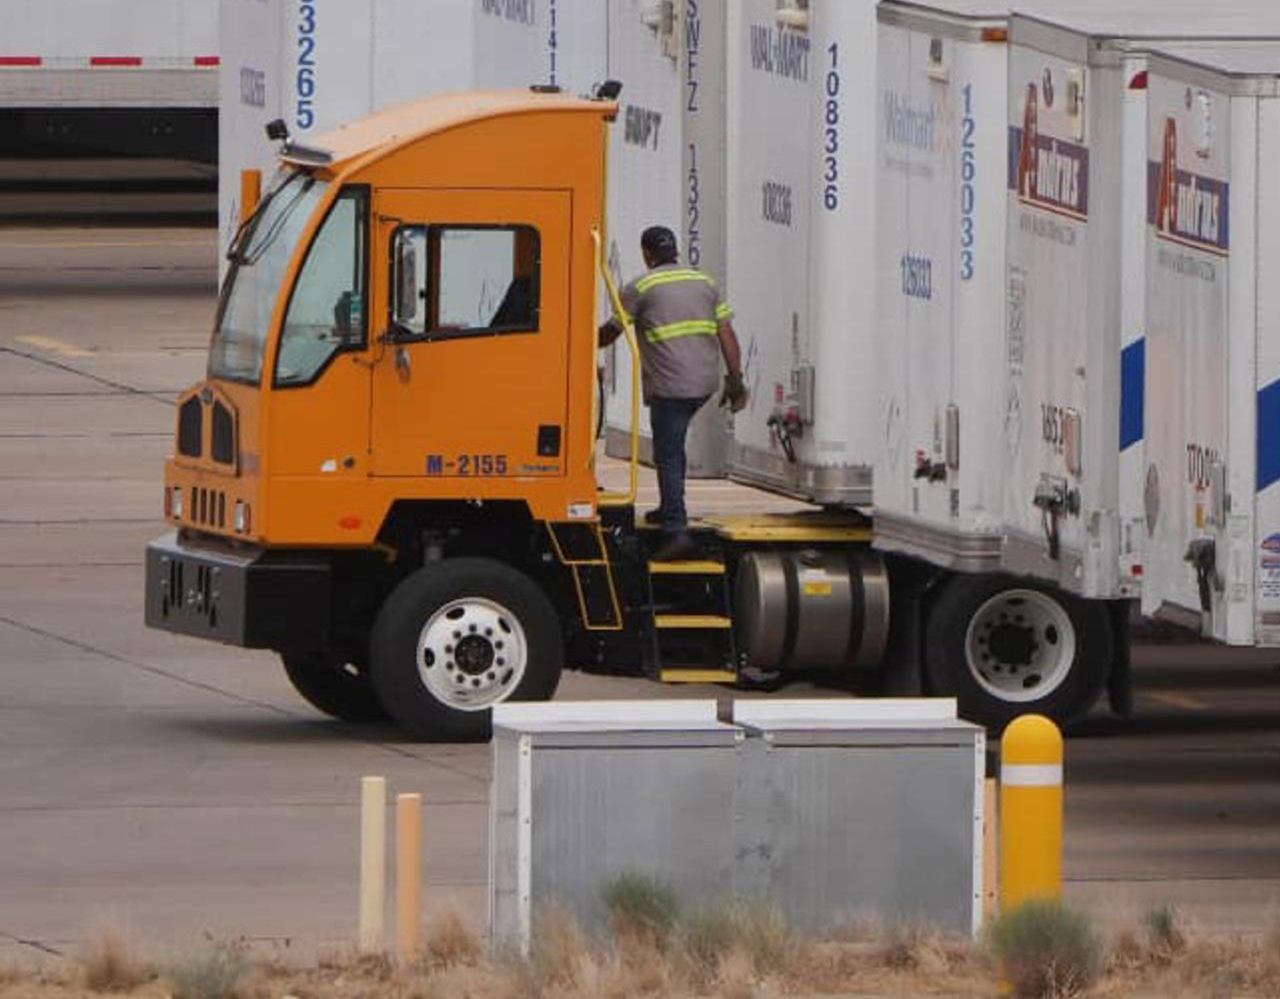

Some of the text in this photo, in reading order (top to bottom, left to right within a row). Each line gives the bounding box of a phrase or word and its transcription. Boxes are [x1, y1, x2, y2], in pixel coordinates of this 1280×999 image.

[823, 42, 840, 210] 108336
[960, 83, 976, 281] 126033
[426, 454, 508, 475] M-2155
